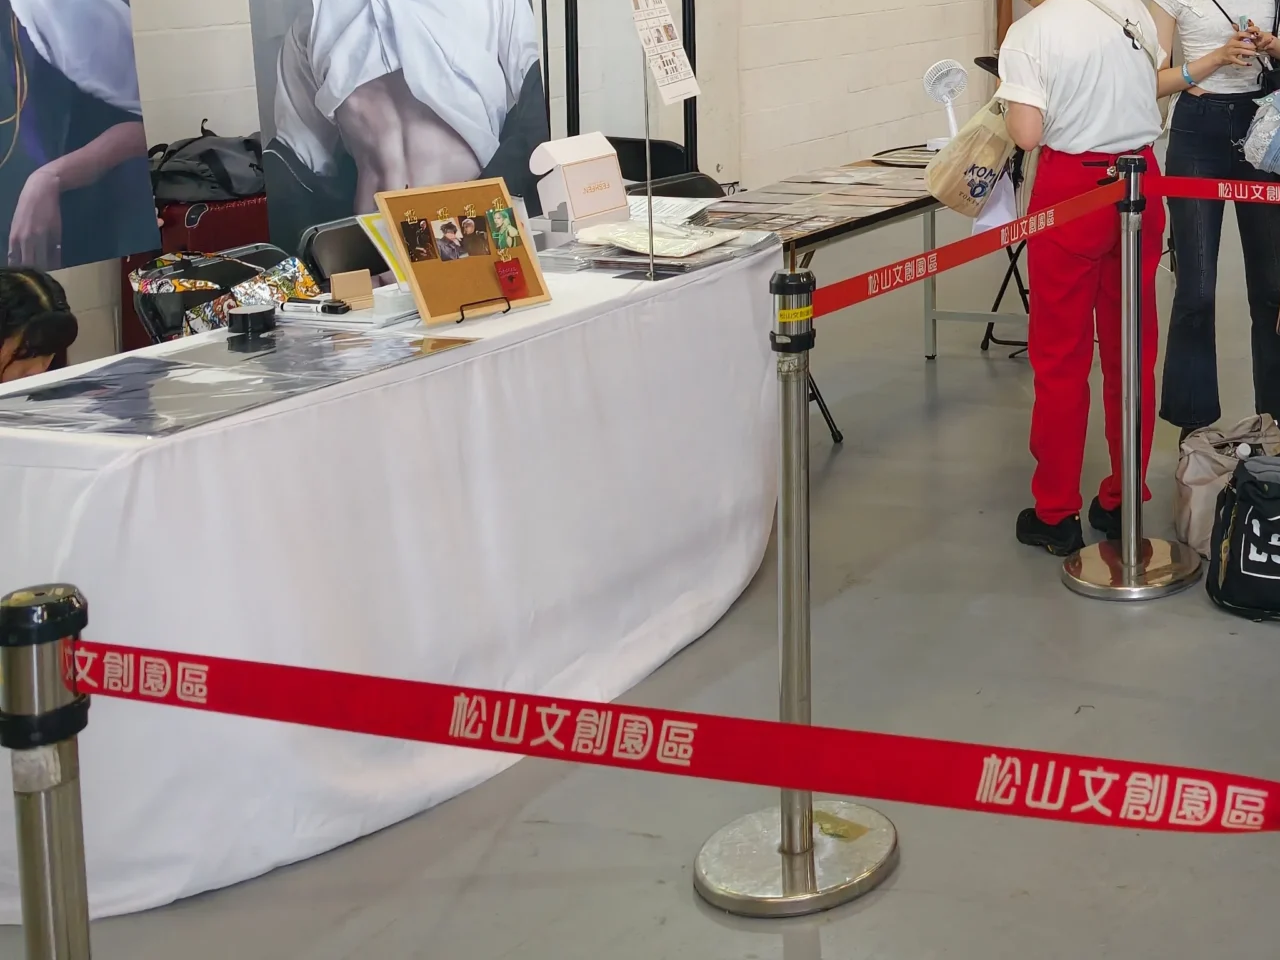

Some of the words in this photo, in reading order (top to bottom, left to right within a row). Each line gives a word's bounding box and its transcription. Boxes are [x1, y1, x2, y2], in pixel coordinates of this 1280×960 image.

[1001, 209, 1055, 246] 松山文創園區
[868, 253, 938, 296] 松山文創園區
[449, 693, 698, 767] 松山文創園區
[975, 754, 1268, 830] 松山文創園區
